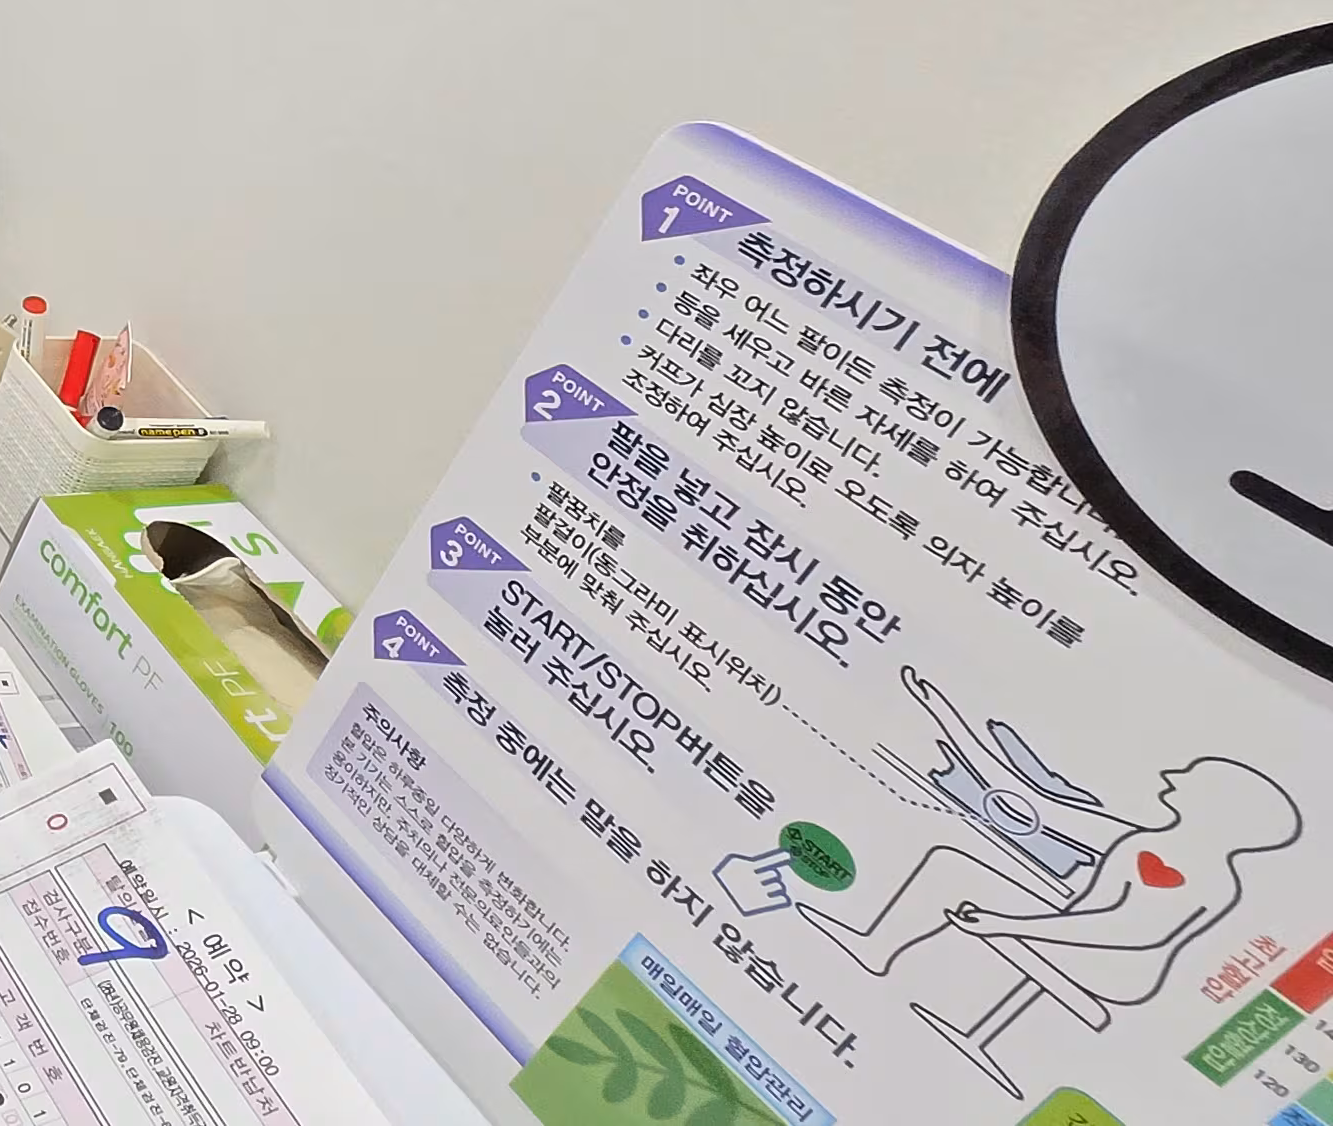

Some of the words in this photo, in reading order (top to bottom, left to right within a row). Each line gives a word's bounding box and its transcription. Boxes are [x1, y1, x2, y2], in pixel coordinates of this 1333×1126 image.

[658, 205, 681, 235] 1
[671, 183, 734, 225] POINT
[690, 261, 739, 300] 좌우
[744, 295, 790, 335] 어느
[798, 324, 876, 385] 팔이든
[879, 377, 966, 438] 측정이
[737, 231, 920, 352] 측정하시기
[923, 333, 1011, 404] 전에
[140, 428, 196, 438] namepen
[533, 390, 562, 421] 2
[551, 370, 606, 413] POINT
[621, 368, 712, 437] 조정하여
[713, 428, 807, 509] 주십시오.
[656, 318, 724, 372] 다리를
[723, 362, 778, 405] 꼬지
[778, 396, 881, 478] 않습니다.
[673, 289, 722, 331] 등을
[723, 321, 795, 379] 세우고
[799, 367, 853, 414] 바른
[855, 404, 940, 467] 자세를
[945, 460, 1008, 508] 하여
[1011, 500, 1139, 596] 주십시오.
[454, 523, 503, 566] POINT
[546, 481, 627, 551] 팔꿈치를
[607, 421, 670, 481] 팔을
[673, 468, 742, 531] 넣고
[744, 518, 821, 587] 잠시
[819, 574, 902, 645] 동안
[637, 343, 704, 399] 커프가
[708, 391, 758, 432] 심장
[755, 424, 834, 486] 높이로
[834, 478, 921, 541] 오도록
[923, 536, 985, 584] 의자
[985, 577, 1086, 649] 높이를
[440, 540, 464, 568] 3
[587, 452, 678, 534] 안정을
[680, 521, 850, 668] 취하십시오.
[40, 539, 133, 661] comfort
[133, 655, 164, 692] PF
[382, 636, 405, 659] 4
[396, 615, 440, 658] POINT
[520, 523, 580, 580] 부분에
[580, 574, 626, 616] 맞춰
[625, 610, 714, 693] 주십시오.
[533, 502, 679, 626] 팔걸이(동그라미
[678, 619, 782, 706] 표시위치)
[15, 593, 70, 669] EXAMINATION
[69, 667, 105, 716] GLOVES
[482, 604, 541, 665] 눌러
[541, 658, 656, 775] 주십시오.
[501, 579, 778, 820] START/STOP버튼을
[108, 721, 134, 758] 100
[362, 702, 427, 772] 주의사항
[350, 722, 388, 764] 혈압은
[388, 762, 440, 818] 하루종일
[440, 815, 496, 874] 다양하게
[324, 763, 373, 818] 정기적인
[372, 816, 410, 858] 상담을
[411, 856, 453, 902] 대체할
[453, 901, 481, 934] 수는
[358, 752, 393, 794] 기기는
[394, 795, 435, 835] 스스로
[435, 833, 477, 879] 혈압을
[477, 877, 564, 968] 측정하기에는
[441, 670, 498, 727] 측정
[495, 719, 577, 806] 중에는
[580, 797, 642, 865] 말을
[646, 858, 715, 928] 하지
[713, 922, 858, 1069] 않습니다.
[21, 897, 71, 966] 접수번호
[42, 888, 93, 956] 검사구분
[77, 906, 169, 966] 9
[120, 859, 169, 922] 예약일시
[176, 941, 243, 1026] 2026-01-28
[240, 1030, 280, 1078] 09:00
[203, 933, 250, 984] 예약
[1200, 934, 1287, 1004] 최고혈압
[204, 1021, 279, 1118] 차트반납처
[640, 954, 723, 1037] 매일매일
[724, 1034, 814, 1123] 혈압관리
[1202, 1002, 1290, 1073] 정상혈압
[1254, 1069, 1290, 1098] 120
[1284, 1044, 1321, 1074] 130
